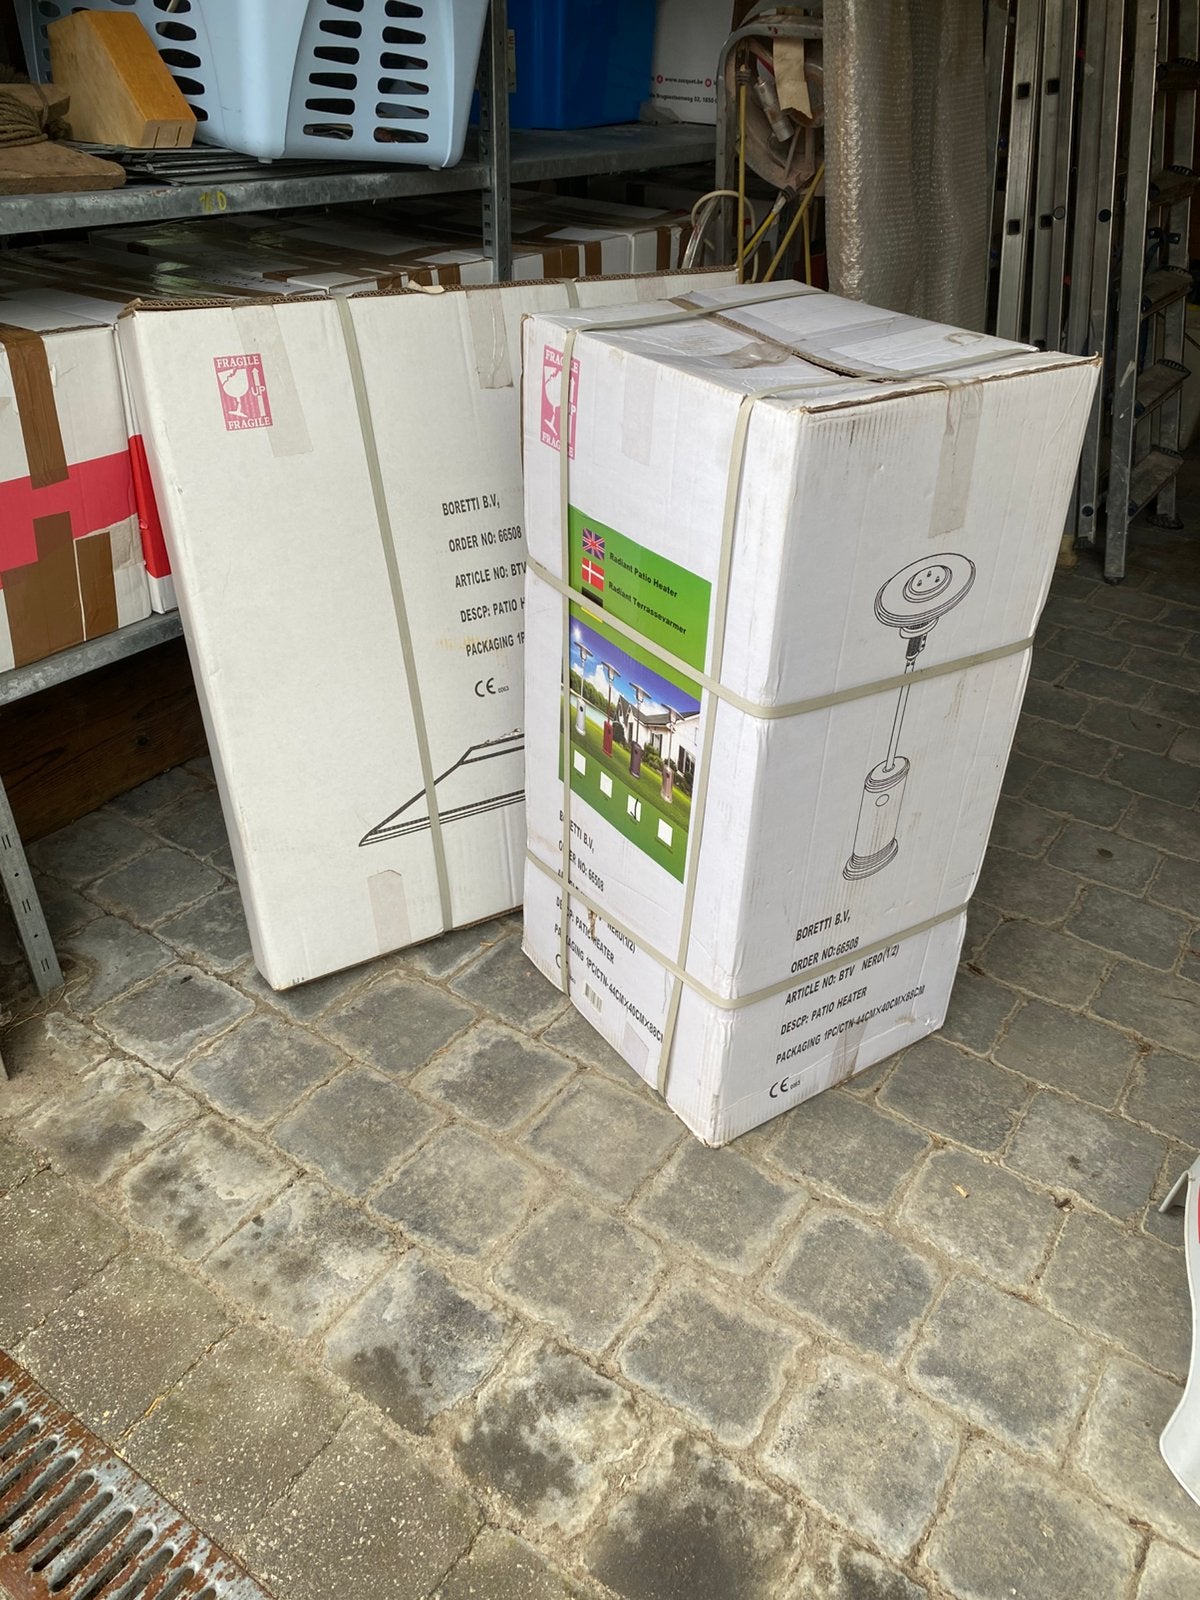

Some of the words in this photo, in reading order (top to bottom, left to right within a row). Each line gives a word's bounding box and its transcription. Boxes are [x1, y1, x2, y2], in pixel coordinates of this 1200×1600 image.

[216, 355, 260, 369] FRAGILE
[544, 348, 579, 374] FRAGE
[251, 385, 266, 396] UP
[227, 416, 271, 430] FRAGILE
[541, 431, 575, 458] FRAGE
[442, 497, 480, 516] BORETTI
[448, 534, 479, 552] ORDER
[481, 531, 497, 546] NO:
[498, 525, 522, 543] 66508
[455, 569, 490, 589] ARTICLE
[493, 565, 509, 580] NO:
[511, 561, 527, 577] BTV
[609, 552, 633, 573] Radiant
[634, 567, 652, 584] Patio
[653, 577, 678, 598] Heater
[460, 605, 491, 623] DESCP:
[493, 598, 518, 616] PATIO
[608, 581, 632, 602] Radiant
[633, 596, 687, 635] Terrassevarmer
[466, 634, 514, 657] PACKAGING
[559, 810, 582, 840] BETTI
[558, 840, 577, 866] OER
[577, 857, 588, 876] NO:
[588, 868, 605, 892] 66508
[554, 923, 585, 961] PAAGING
[796, 916, 833, 942] BORETTI
[790, 951, 819, 974] ORDER
[785, 980, 820, 1006] ARTICLE
[821, 974, 837, 989] NO:
[838, 965, 856, 981] BTV
[780, 1014, 809, 1036] DESCP:
[811, 1001, 835, 1022] PATIO
[836, 986, 868, 1010] HEATER
[775, 1034, 821, 1065] PACKAGING
